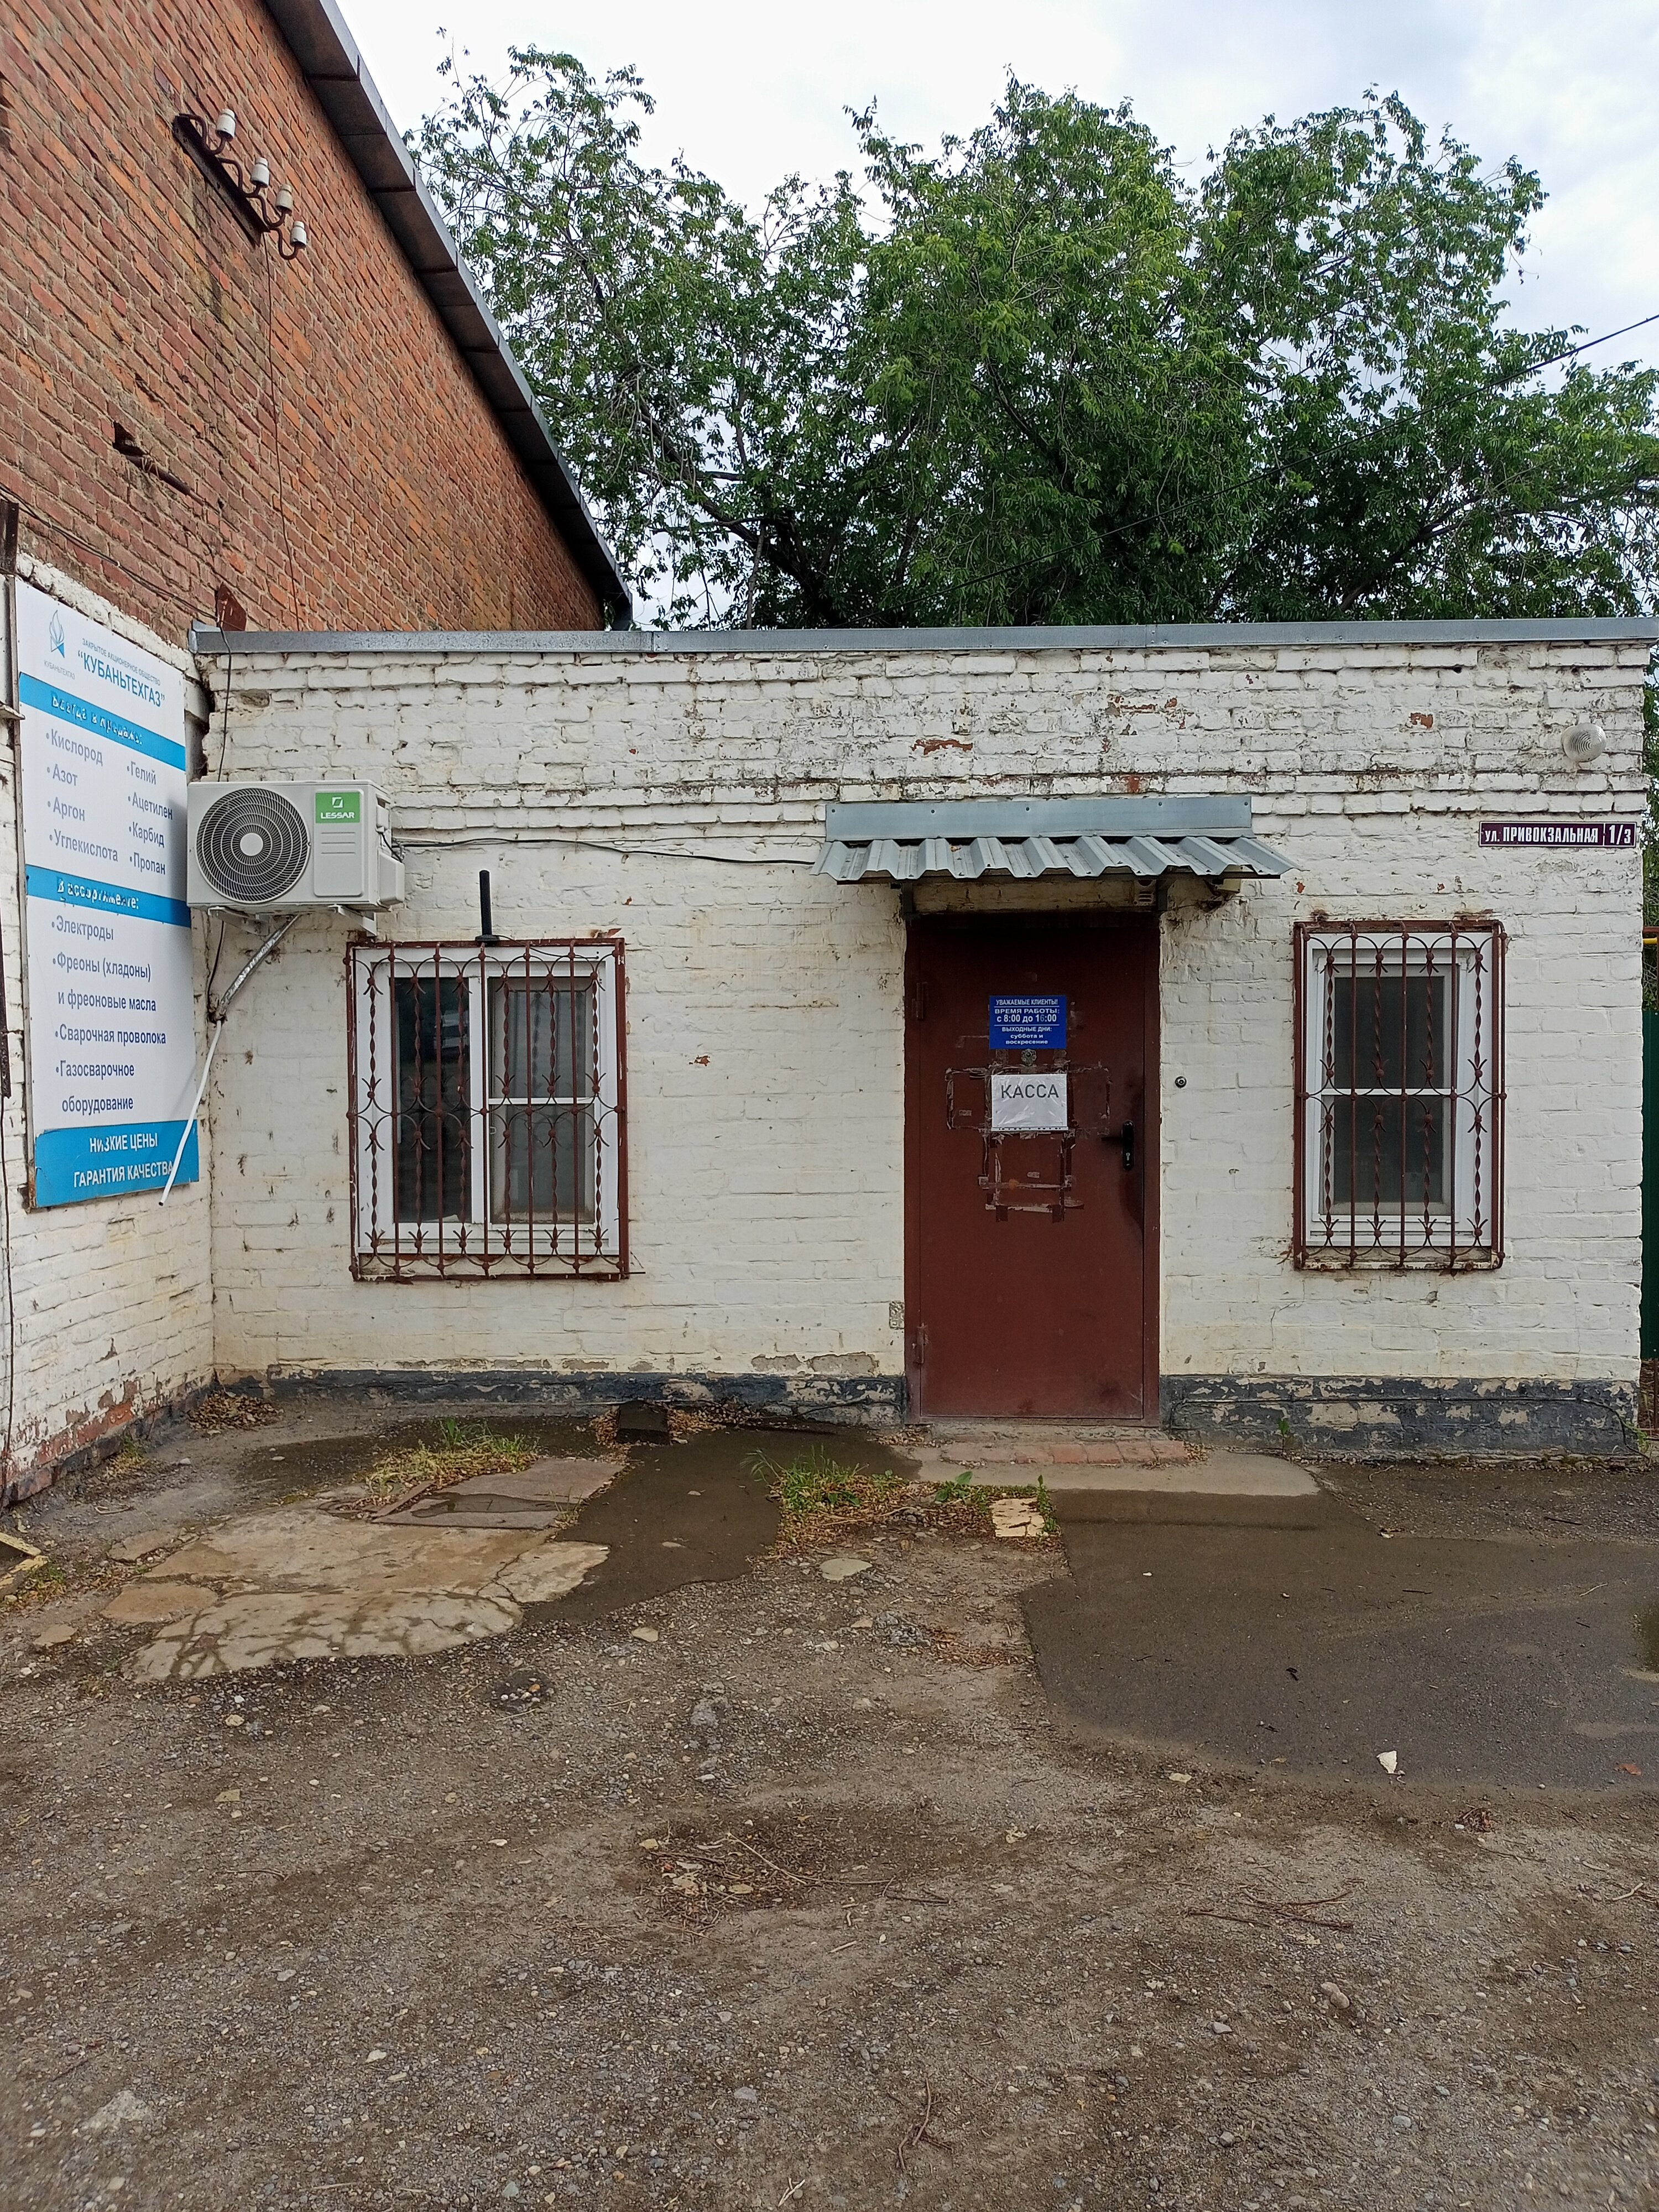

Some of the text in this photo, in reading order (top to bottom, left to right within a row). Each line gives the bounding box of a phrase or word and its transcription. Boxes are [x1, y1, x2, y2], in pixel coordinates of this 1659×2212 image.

[44, 660, 75, 680] КУБАНЬТЕХГАЗ
[82, 638, 160, 686] ЗАКРЫТОЕ АКЦИОНЕРНОЕ ОБЩЕСТВО
[51, 728, 103, 766] Кислород
[53, 763, 78, 786] Азот
[131, 761, 156, 785] Гелий
[53, 796, 85, 821] Аргон
[132, 792, 173, 820] Ацетилен
[320, 811, 355, 820] LESSAR
[54, 829, 118, 862] Углекислота
[132, 821, 165, 848] Карбид
[1485, 824, 1631, 845] ул. ПРИВОКЗАЛЬНАЯ 1/3
[134, 852, 166, 875] Пропан
[56, 915, 113, 942] Электроды
[57, 951, 151, 983] Фреоны (хладоны)
[58, 989, 156, 1011] и фреоновые масла
[1004, 1014, 1021, 1022] 8:00
[1022, 1015, 1033, 1024] до
[1035, 1014, 1057, 1022] 16:00
[60, 1023, 166, 1047] Сварочная проволока
[60, 1060, 135, 1080] Газосварочное
[1000, 1084, 1059, 1099] КАССА
[62, 1095, 134, 1116] оборудование
[130, 1133, 158, 1152] ЦЕНЫ
[74, 1160, 174, 1188] ГАРАНТИЯ КАЧЕСТВА
